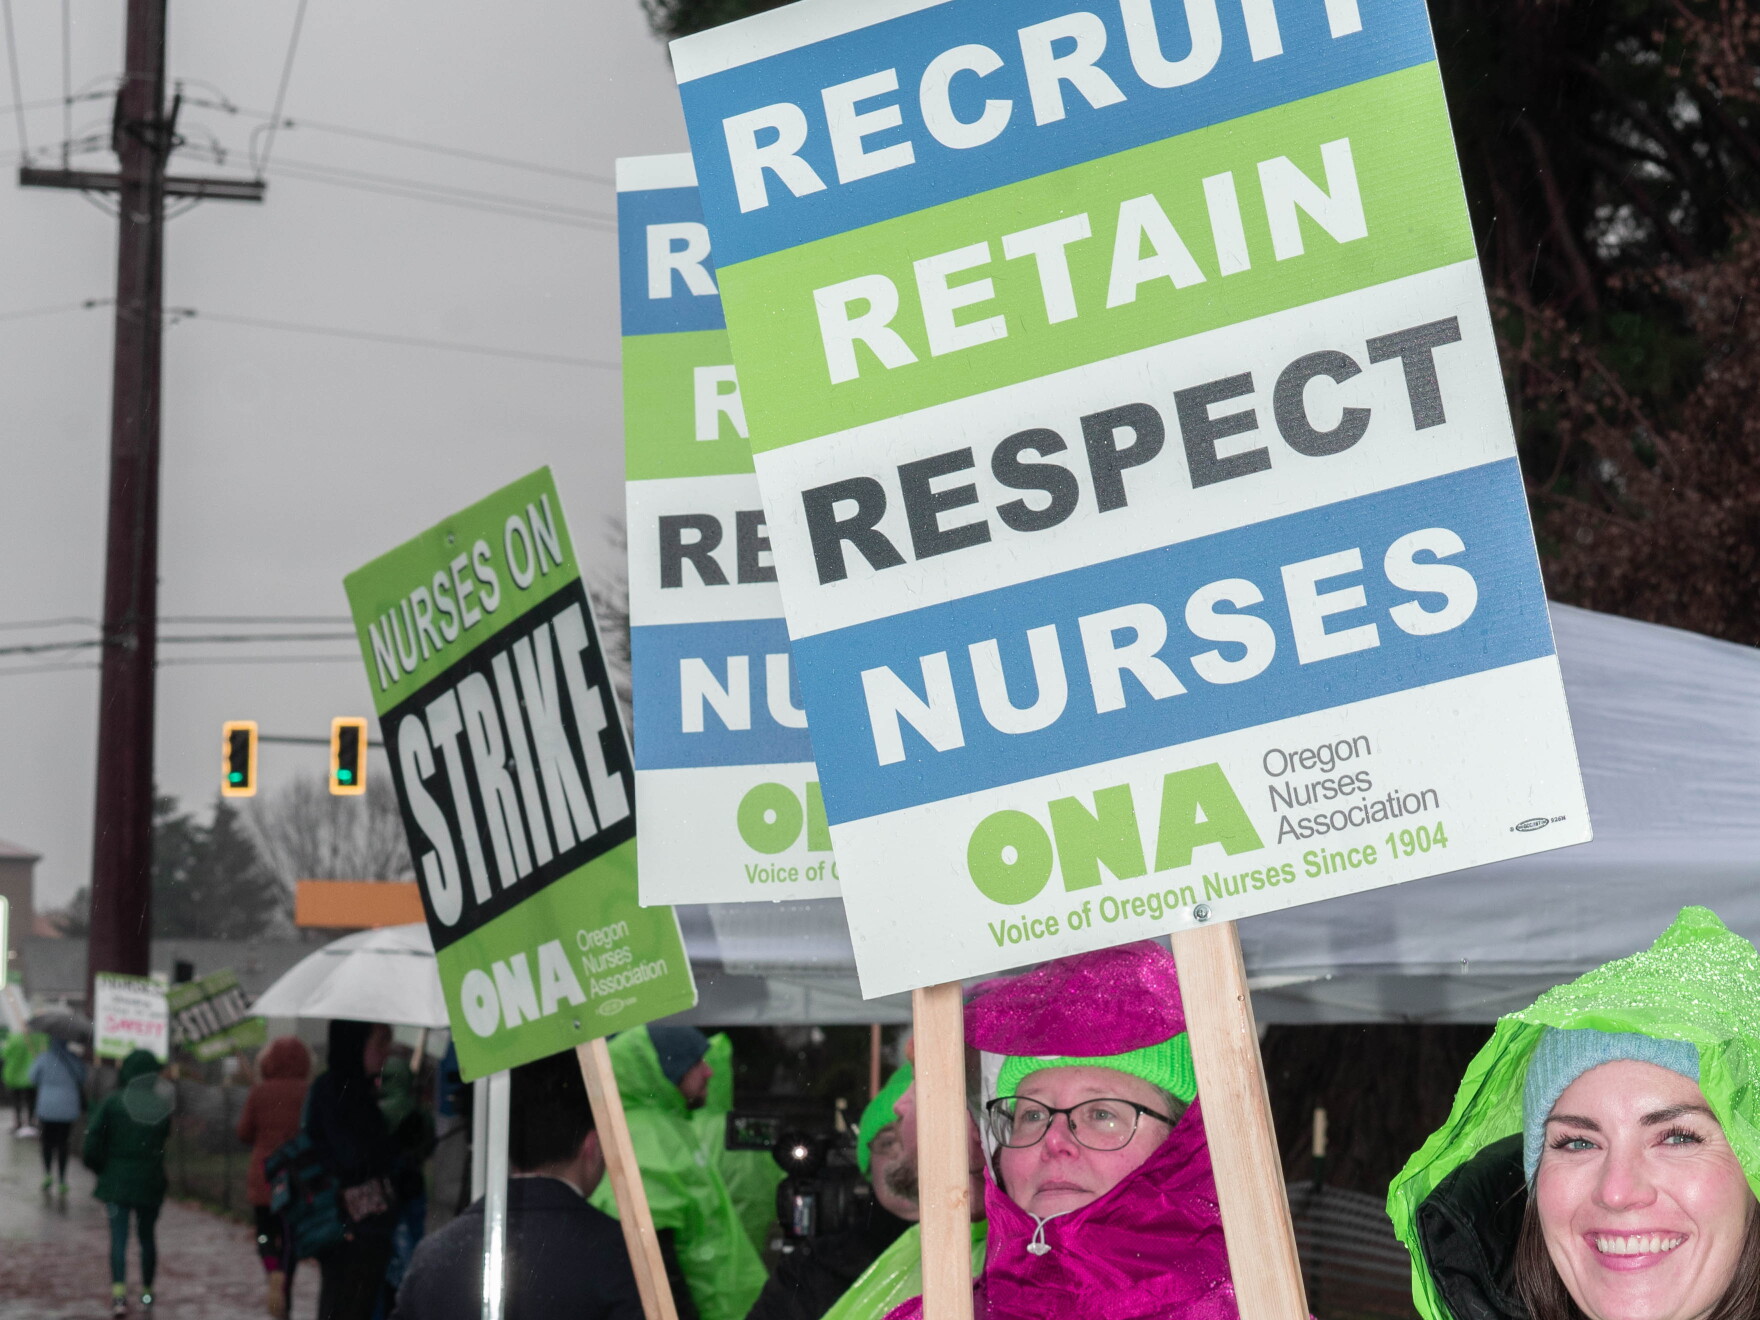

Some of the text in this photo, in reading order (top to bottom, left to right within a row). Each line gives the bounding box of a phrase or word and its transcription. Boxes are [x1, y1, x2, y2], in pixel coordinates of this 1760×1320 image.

[813, 137, 1368, 385] RETAIN
[801, 316, 1462, 585] RESPECT
[368, 493, 563, 691] NURSES ON
[860, 527, 1478, 766] NURSES
[398, 601, 630, 927] STRIKE
[1263, 735, 1371, 777] Oregon
[1268, 770, 1373, 812] Nurses
[967, 762, 1265, 905] ONA
[1277, 787, 1440, 845] Association
[744, 862, 799, 884] Voice
[805, 860, 826, 882] of
[988, 820, 1448, 948] Voice of Oregon Nurses Since 1904
[577, 921, 629, 951] Oregon
[582, 946, 632, 976] Nurses
[590, 959, 667, 999] Association
[460, 939, 587, 1038] ONA
